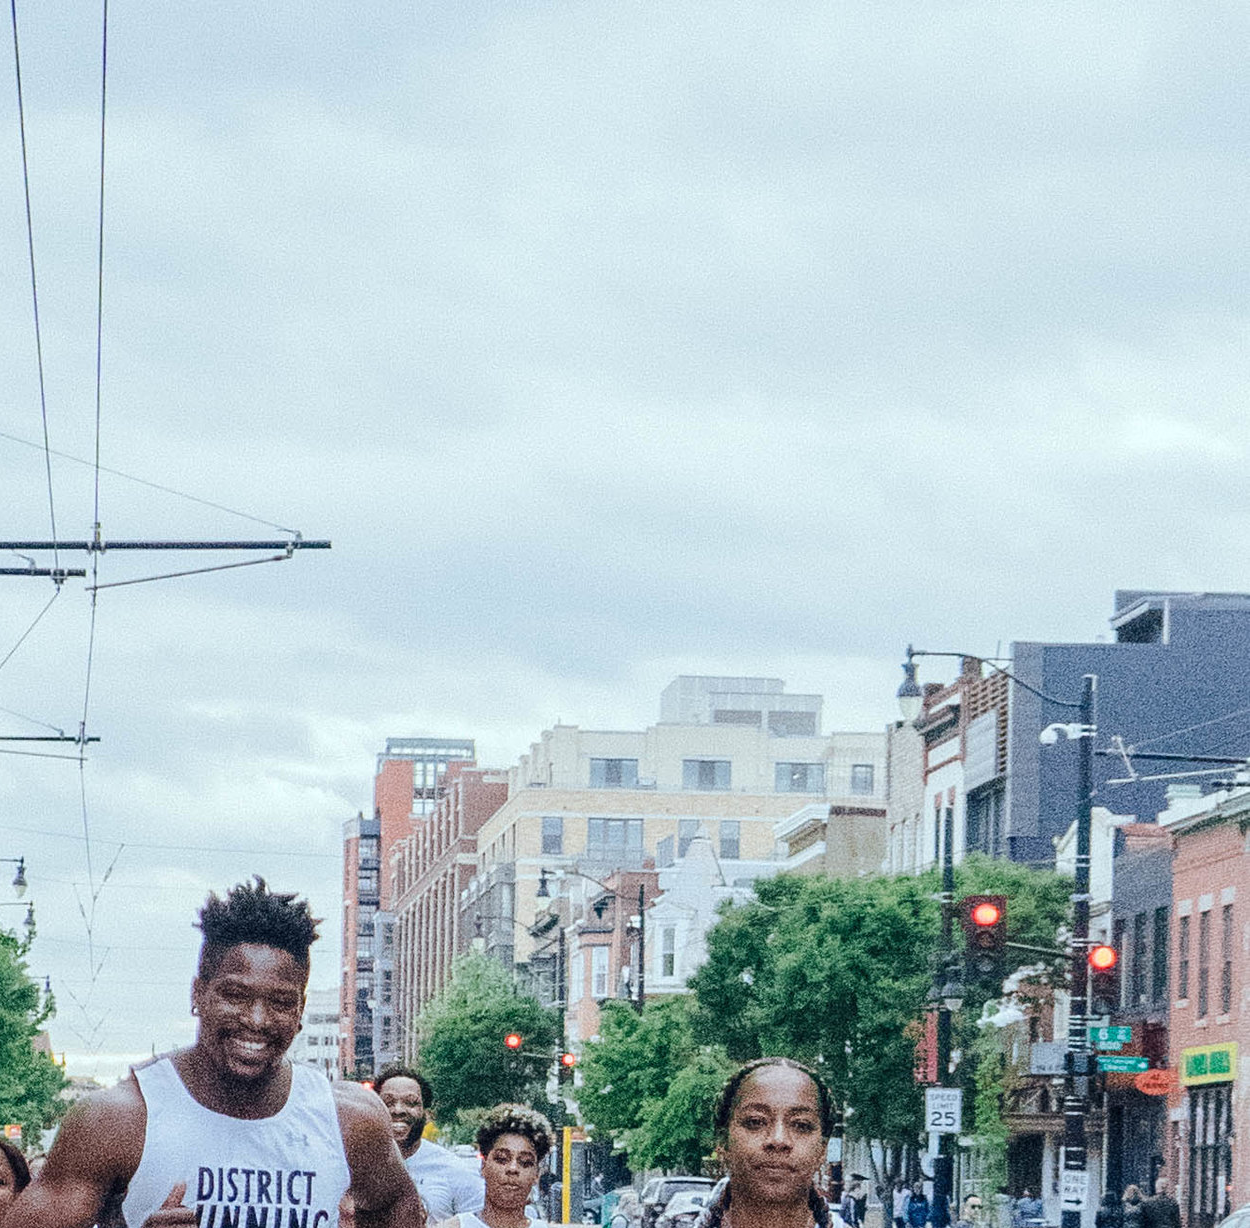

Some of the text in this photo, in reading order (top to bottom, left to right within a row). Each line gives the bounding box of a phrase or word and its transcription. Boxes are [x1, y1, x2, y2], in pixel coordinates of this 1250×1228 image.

[1099, 1028, 1109, 1040] 6
[930, 1093, 958, 1101] SPEED
[932, 1102, 954, 1110] LIMIT
[931, 1111, 956, 1126] 25
[1064, 1174, 1087, 1185] ONE
[197, 1166, 317, 1206] DISTRICT
